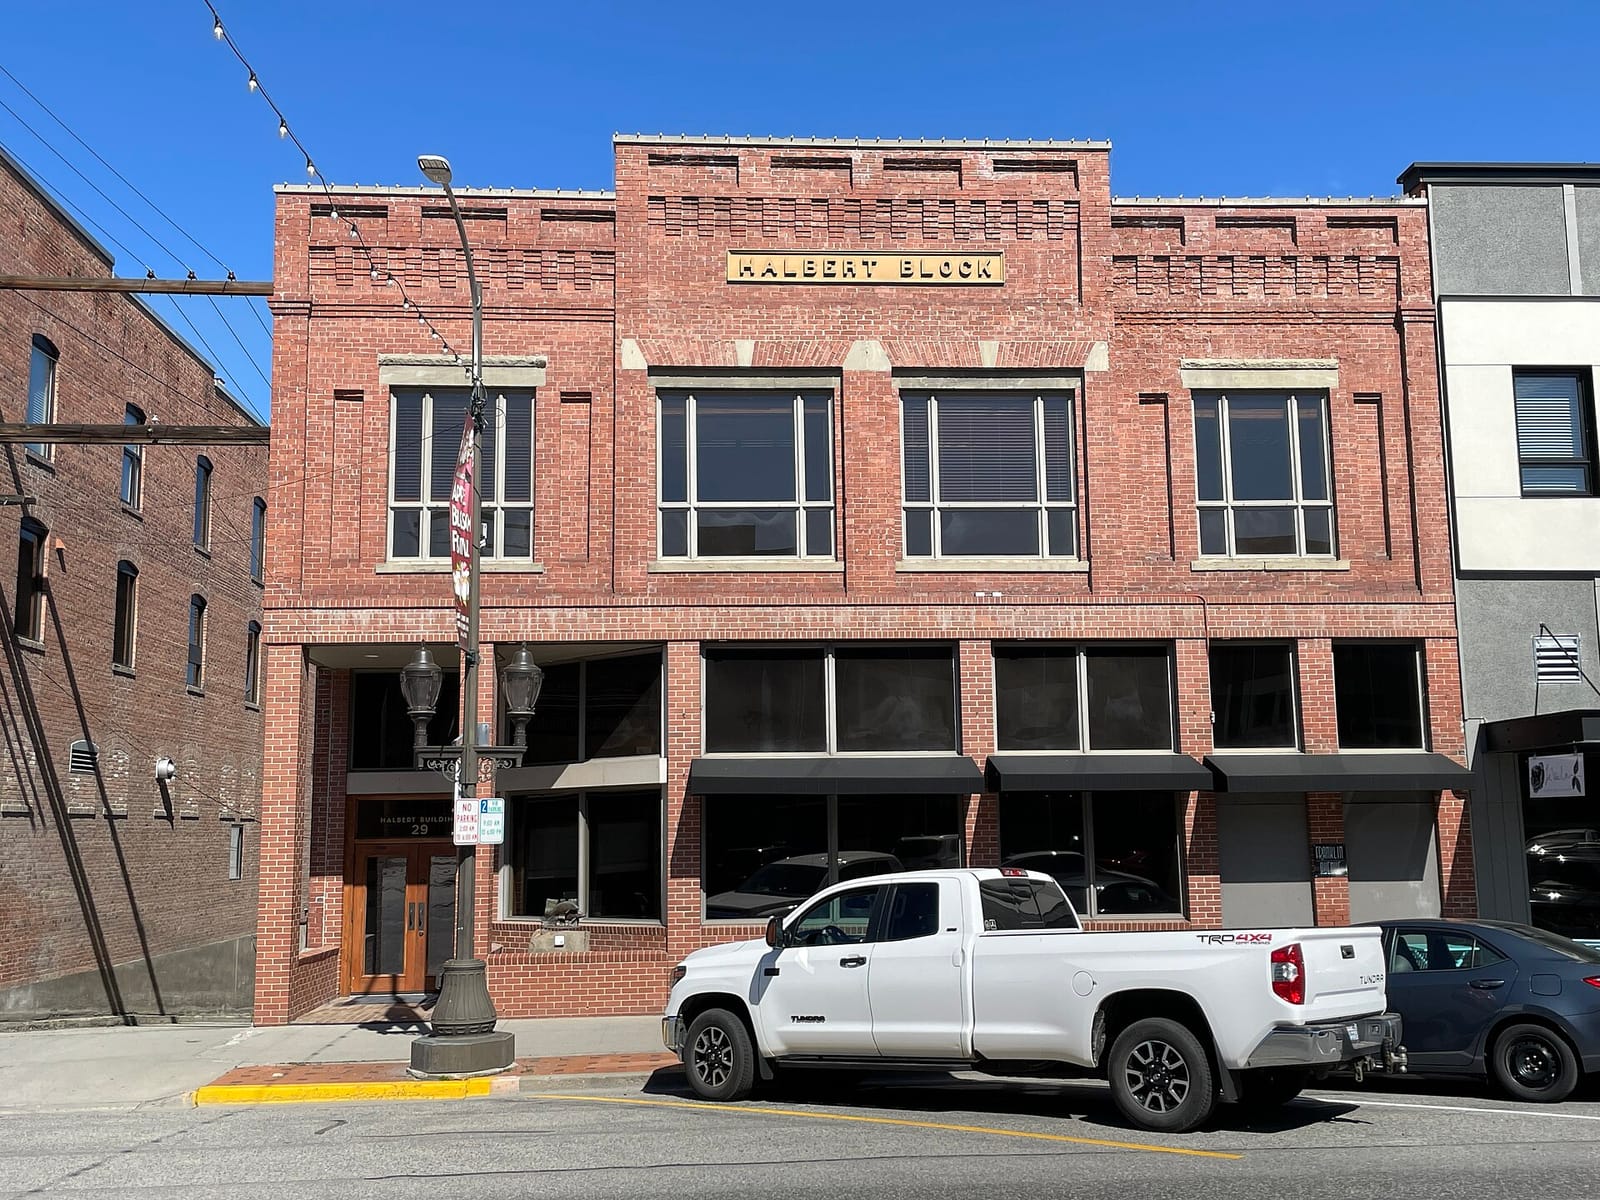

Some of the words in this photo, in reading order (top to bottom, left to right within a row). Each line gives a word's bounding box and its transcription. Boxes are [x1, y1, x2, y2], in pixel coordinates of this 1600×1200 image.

[739, 257, 877, 278] HALBERT
[900, 258, 993, 279] BLOCK
[462, 803, 472, 812] NO
[481, 800, 487, 813] 2
[380, 816, 416, 824] HALBERT
[411, 824, 428, 835] 29
[1196, 934, 1235, 945] TRD
[1360, 974, 1384, 985] TUNDRA
[791, 1015, 826, 1023] TUNDRA
